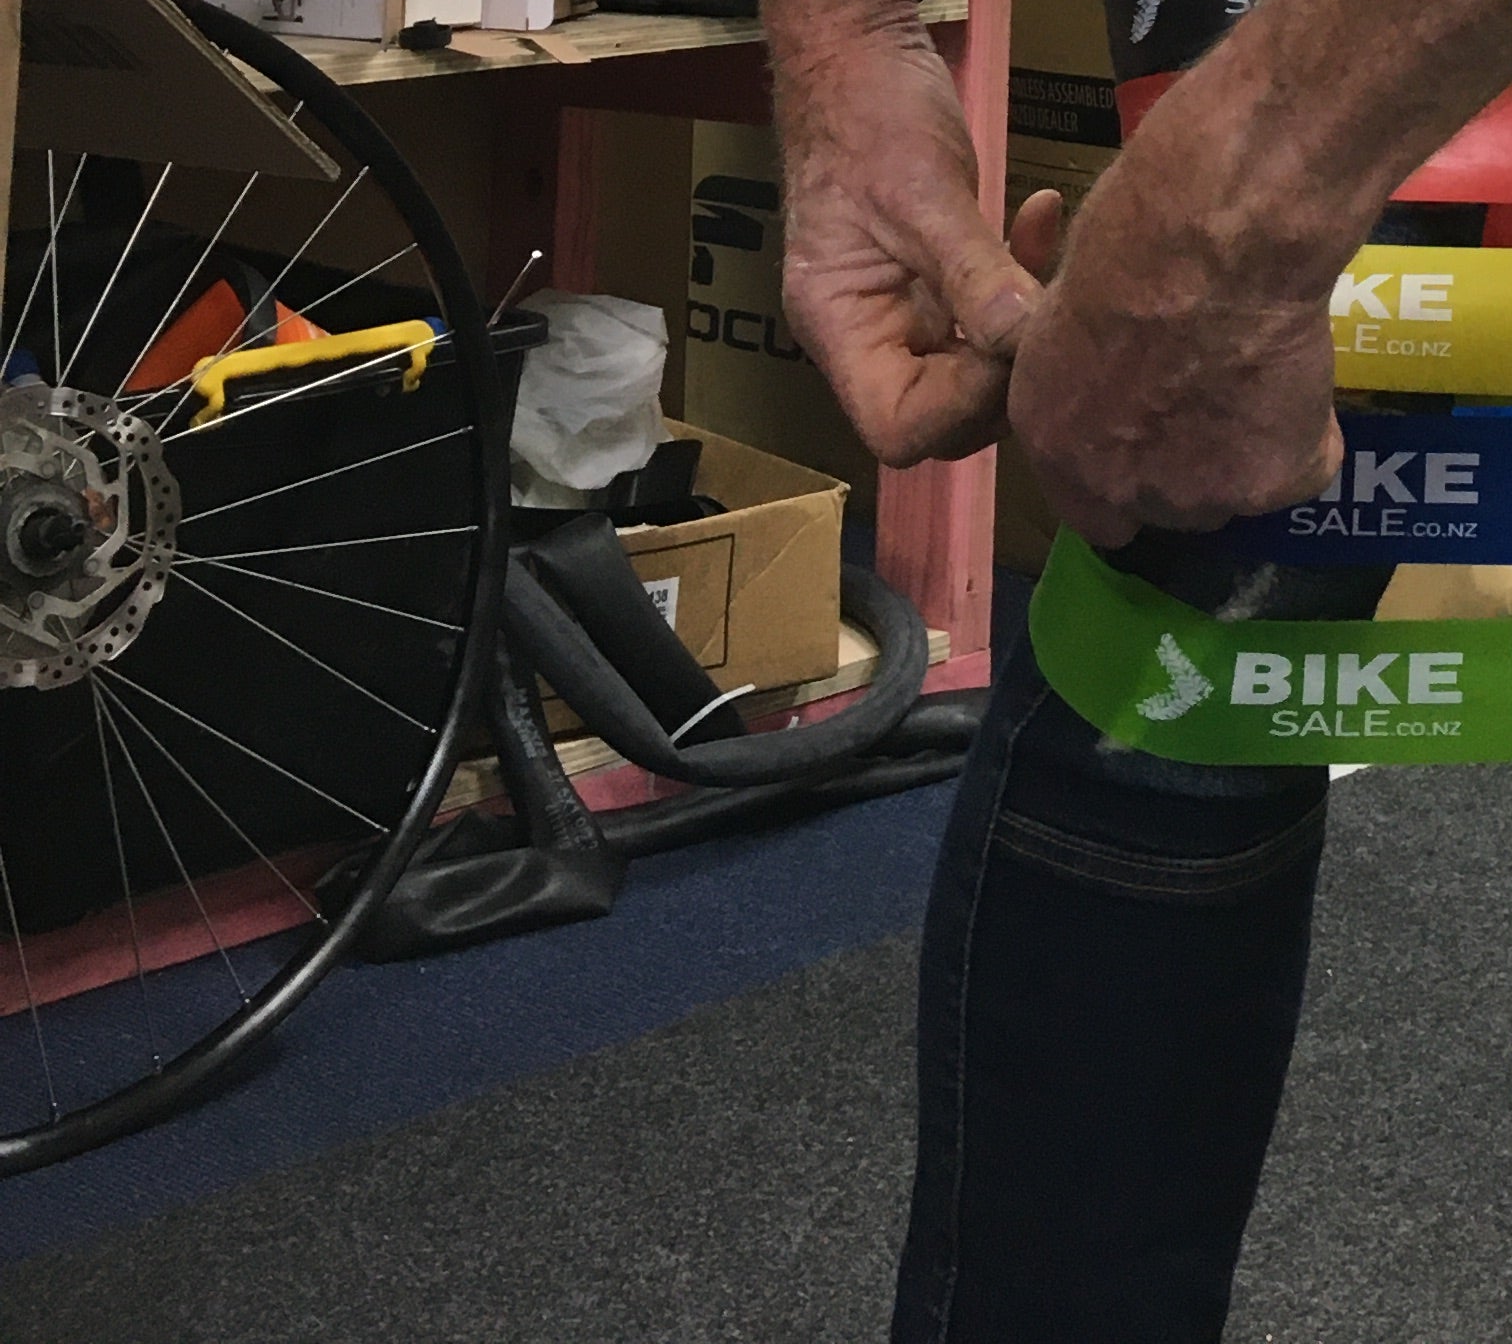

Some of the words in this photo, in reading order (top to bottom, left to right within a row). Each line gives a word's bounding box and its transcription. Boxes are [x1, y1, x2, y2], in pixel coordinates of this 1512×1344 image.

[1047, 81, 1115, 109] ASSEMBLED
[1318, 451, 1481, 504] IKE
[1288, 508, 1478, 540] SALE.CO.NZ
[1230, 652, 1464, 706] BIKE
[1269, 709, 1463, 737] SALE.CO.NZ
